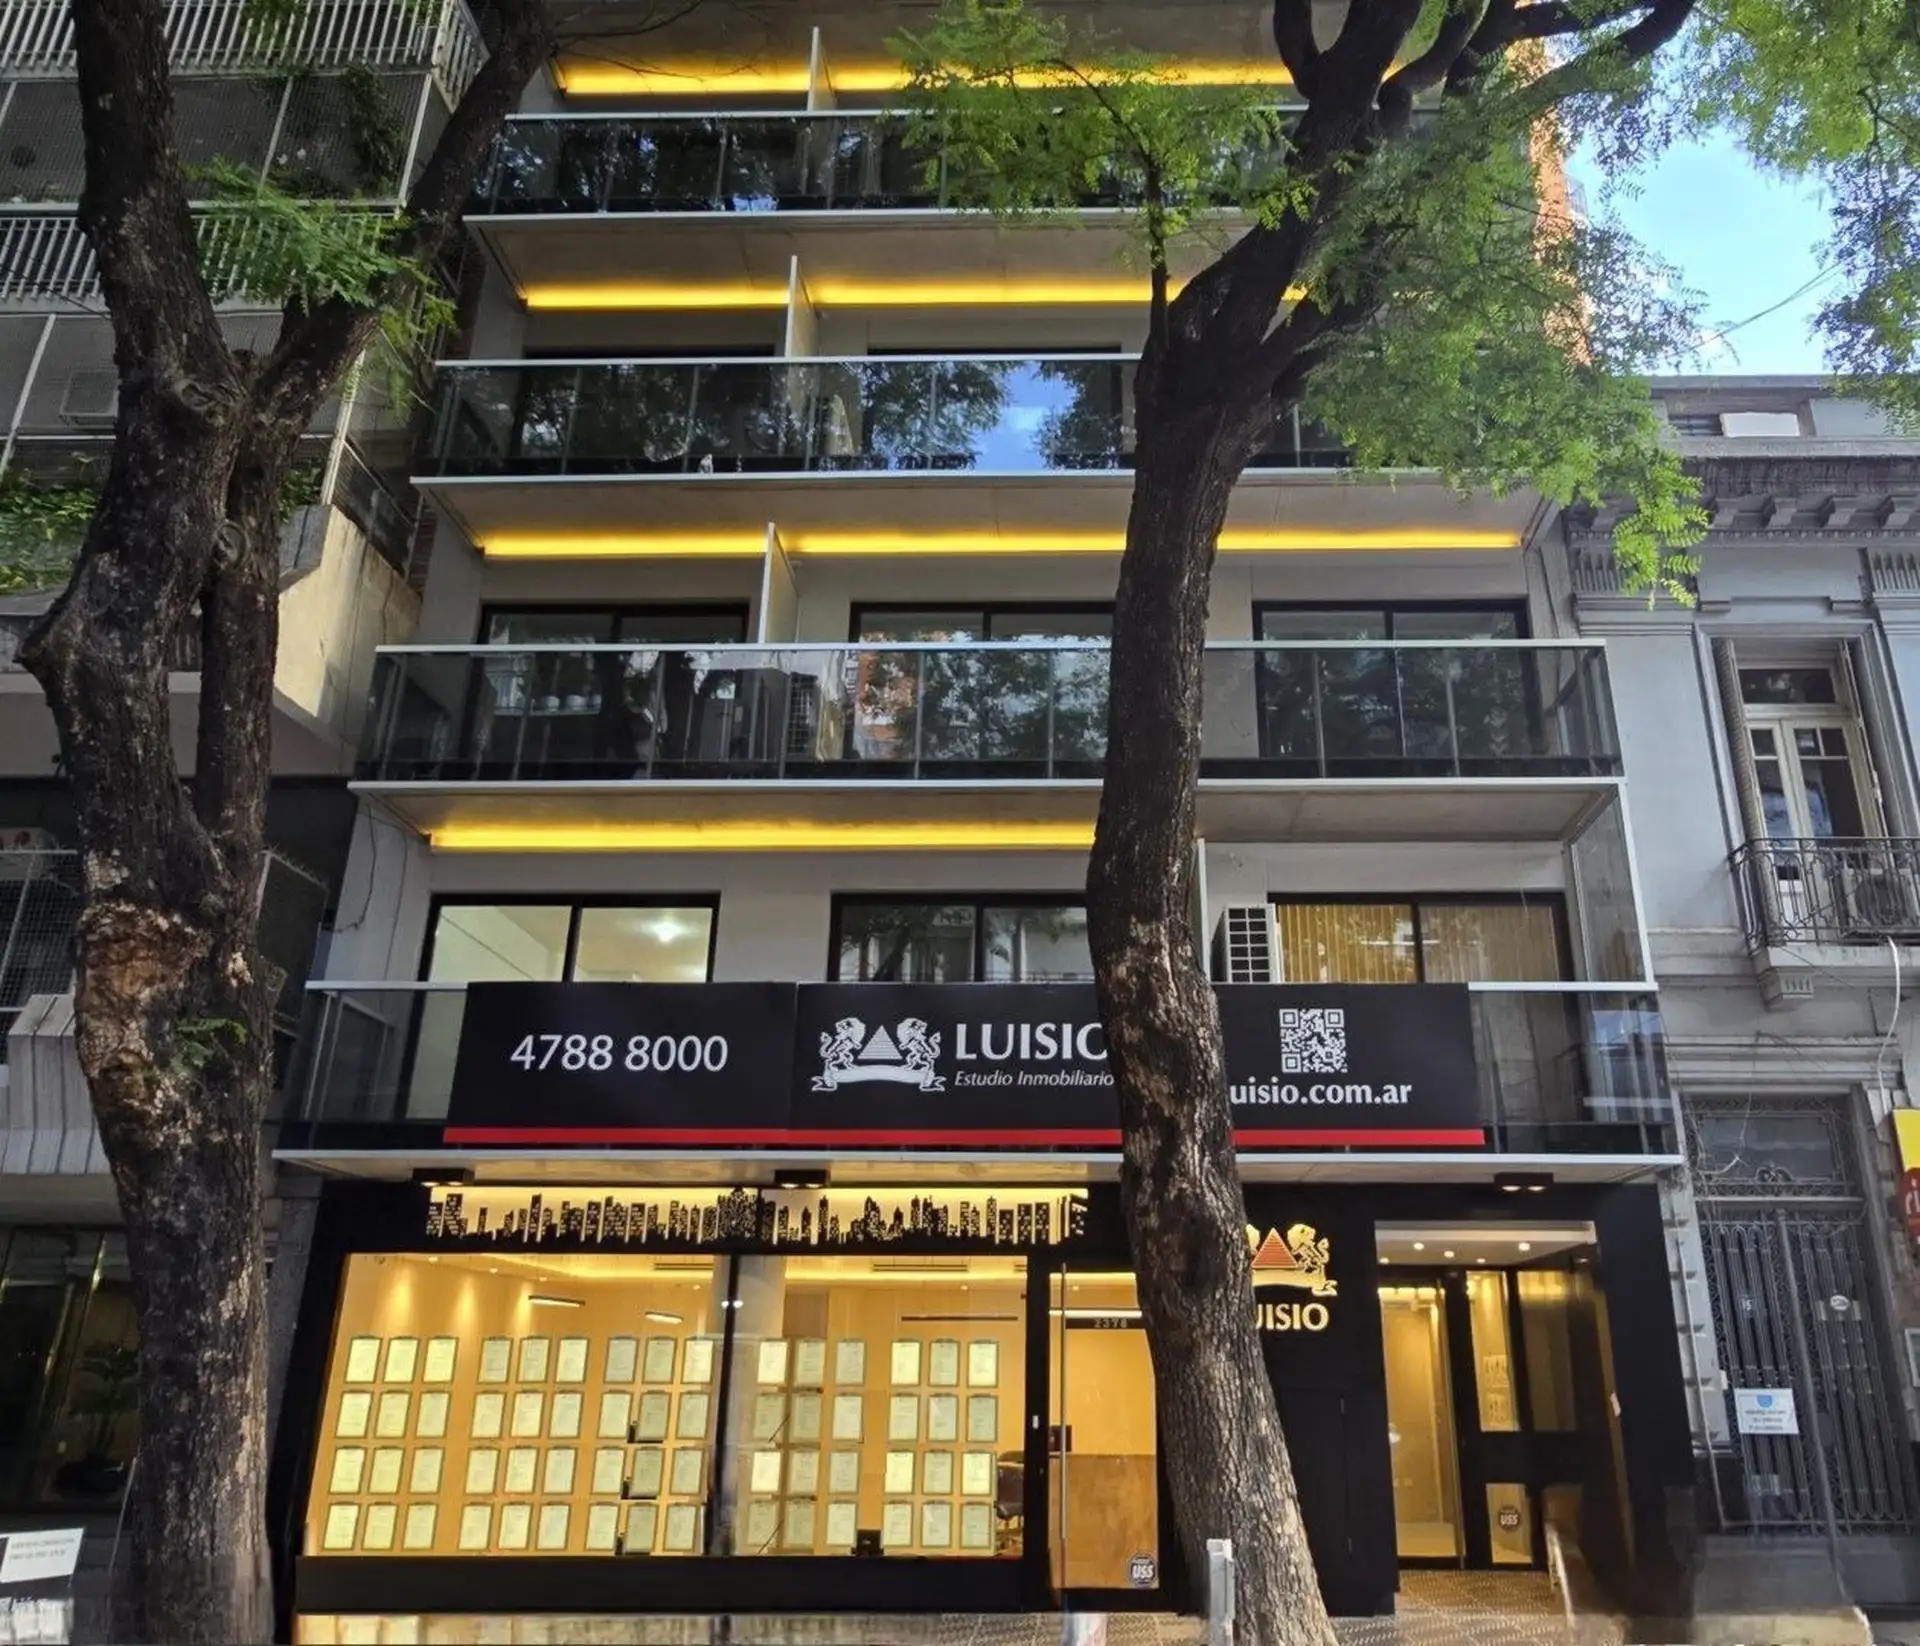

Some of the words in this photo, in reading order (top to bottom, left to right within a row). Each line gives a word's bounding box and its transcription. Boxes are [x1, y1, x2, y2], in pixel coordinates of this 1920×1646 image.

[510, 1034, 614, 1071] 4788
[624, 1035, 728, 1071] 8000
[955, 1069, 1013, 1086] Estudio
[1017, 1069, 1115, 1086] Inmobiliario
[1229, 1076, 1413, 1105] uisio.com.ar
